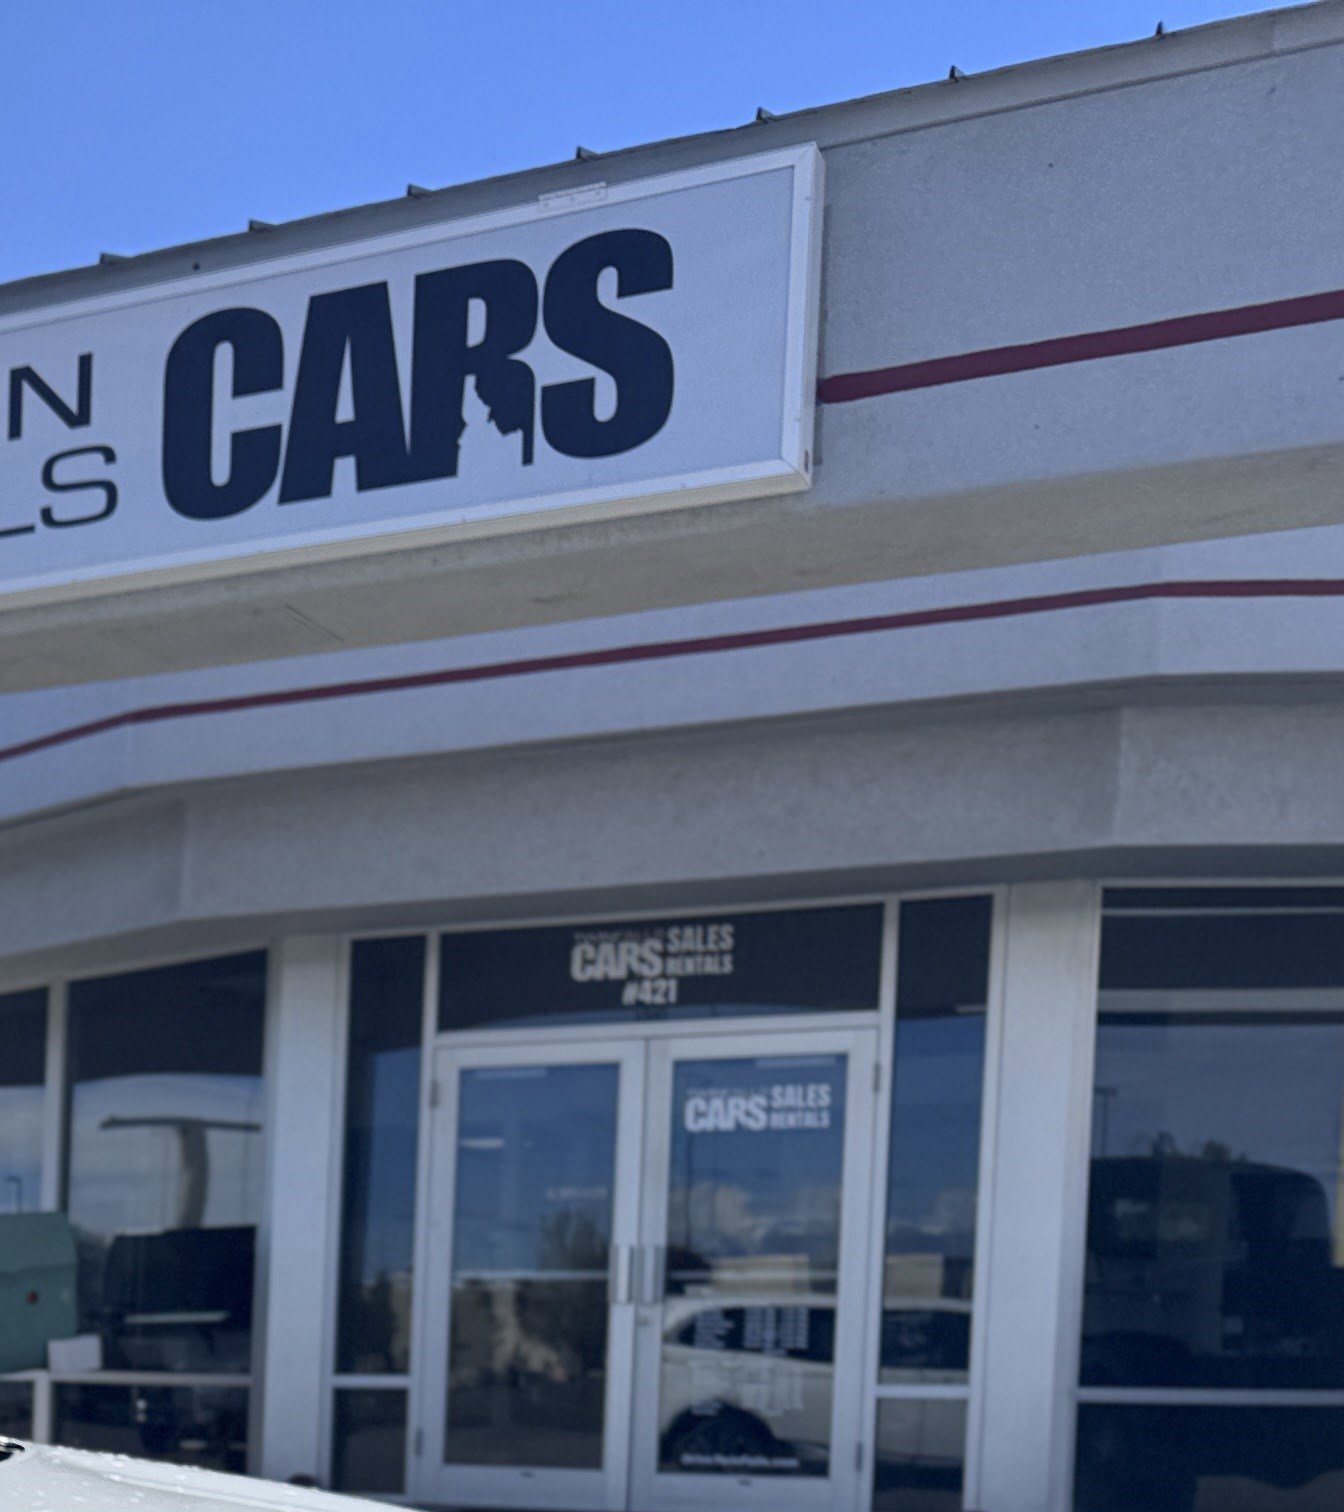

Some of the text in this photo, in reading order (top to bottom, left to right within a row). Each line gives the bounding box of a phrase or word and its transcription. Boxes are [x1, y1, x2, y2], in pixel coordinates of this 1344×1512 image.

[161, 227, 675, 522] CARS
[667, 924, 734, 953] SALES
[571, 938, 663, 982] CARS
[666, 954, 733, 975] RENTALS
[622, 978, 678, 1005] #421
[770, 1083, 832, 1109] SALES
[683, 1094, 768, 1133] CARS
